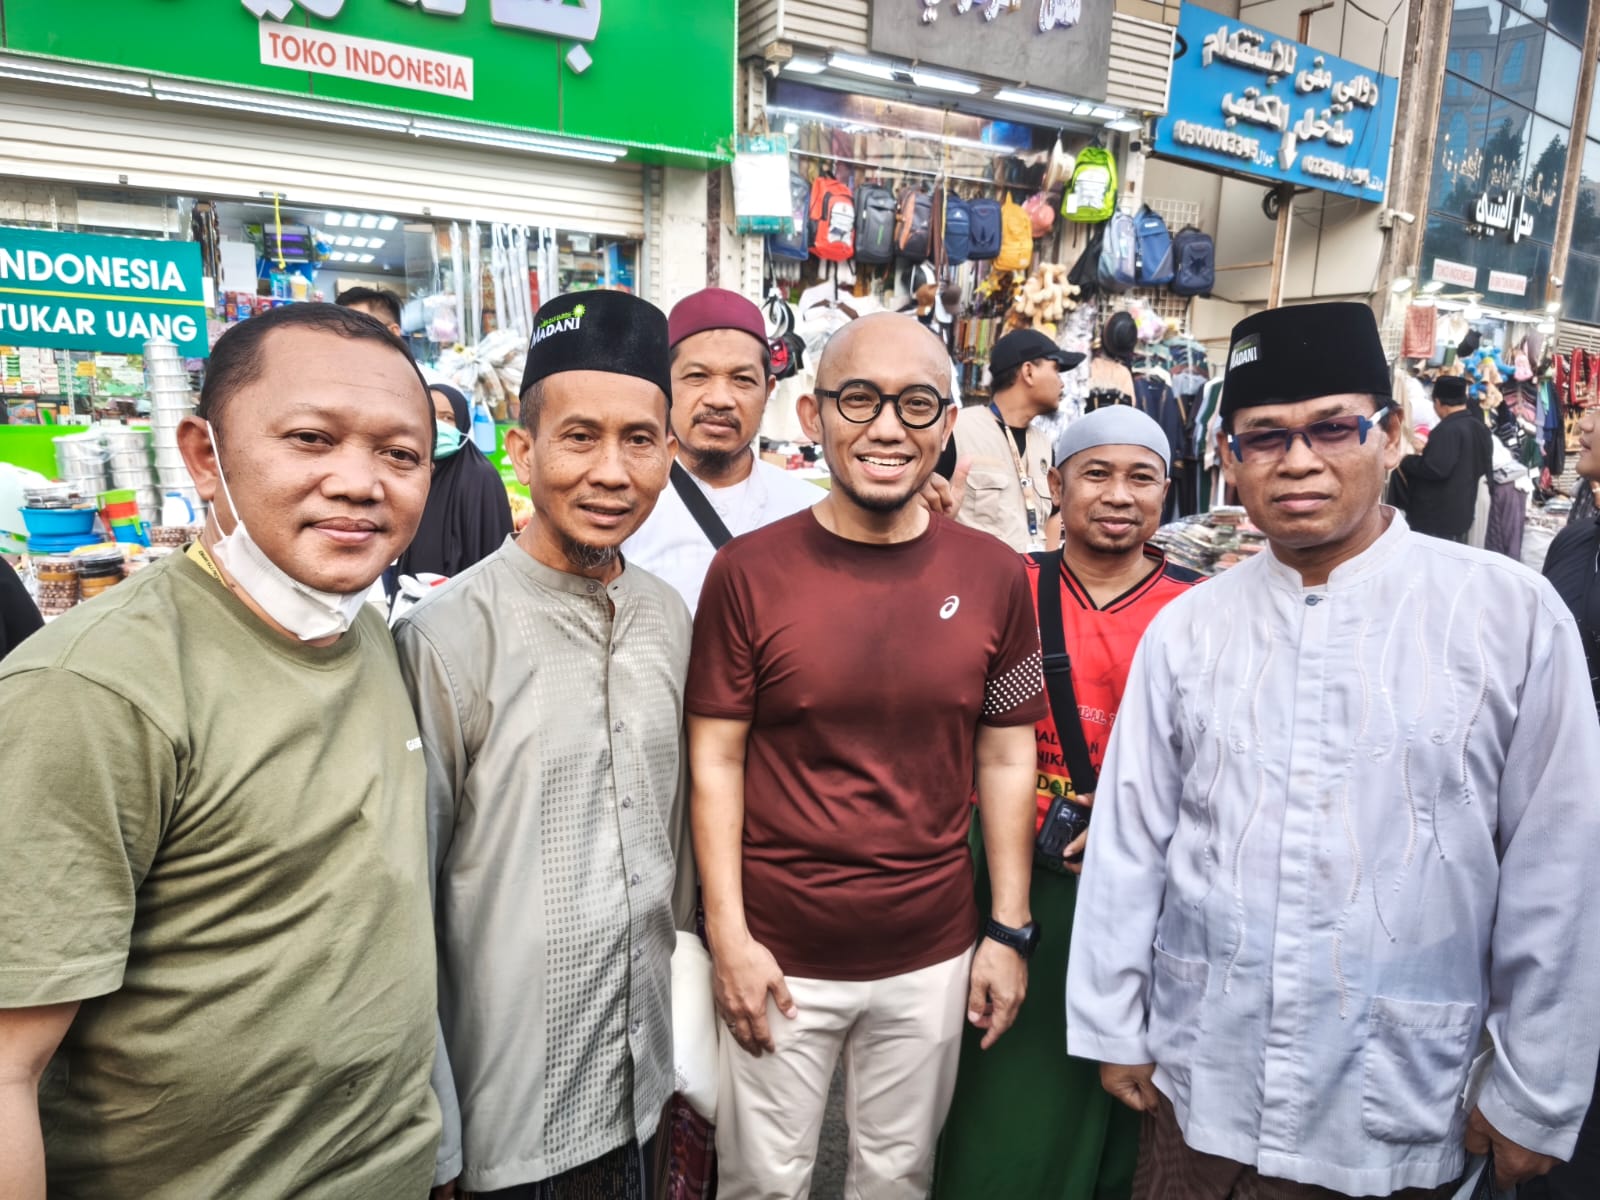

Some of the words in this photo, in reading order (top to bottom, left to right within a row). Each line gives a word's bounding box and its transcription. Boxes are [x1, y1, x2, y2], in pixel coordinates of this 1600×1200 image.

[268, 32, 337, 67] TOKO
[345, 46, 468, 92] INDONESIA
[0, 248, 187, 292] NDONESIA
[106, 310, 197, 342] UANG
[530, 317, 581, 349] MADANI
